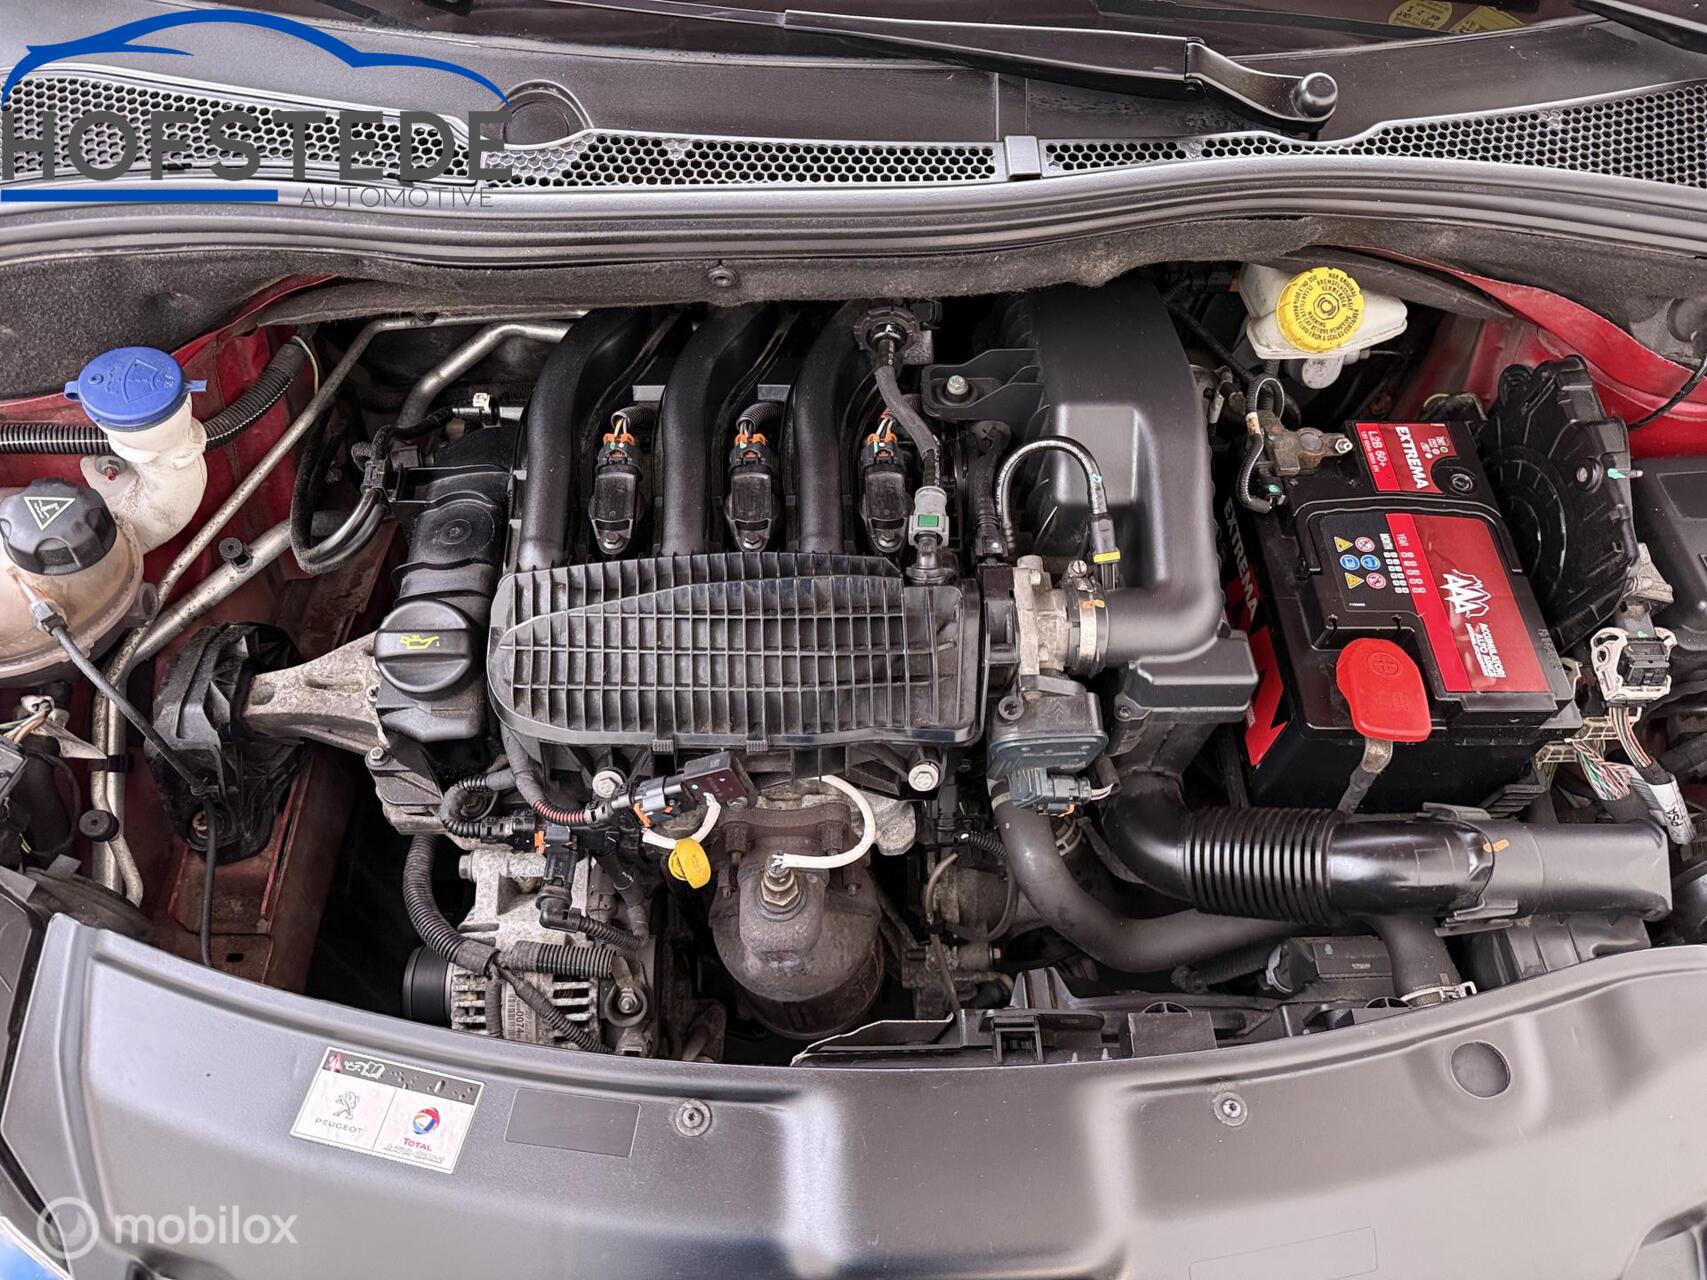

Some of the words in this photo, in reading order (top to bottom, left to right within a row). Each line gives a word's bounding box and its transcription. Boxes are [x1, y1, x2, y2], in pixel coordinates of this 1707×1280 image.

[1368, 431, 1384, 449] L2B
[1375, 450, 1388, 468] 60+
[1394, 426, 1430, 489] EXTREMA
[1224, 497, 1258, 622] EXTREMA
[315, 1118, 364, 1134] PEUGEOT
[403, 1138, 433, 1152] TOTAL
